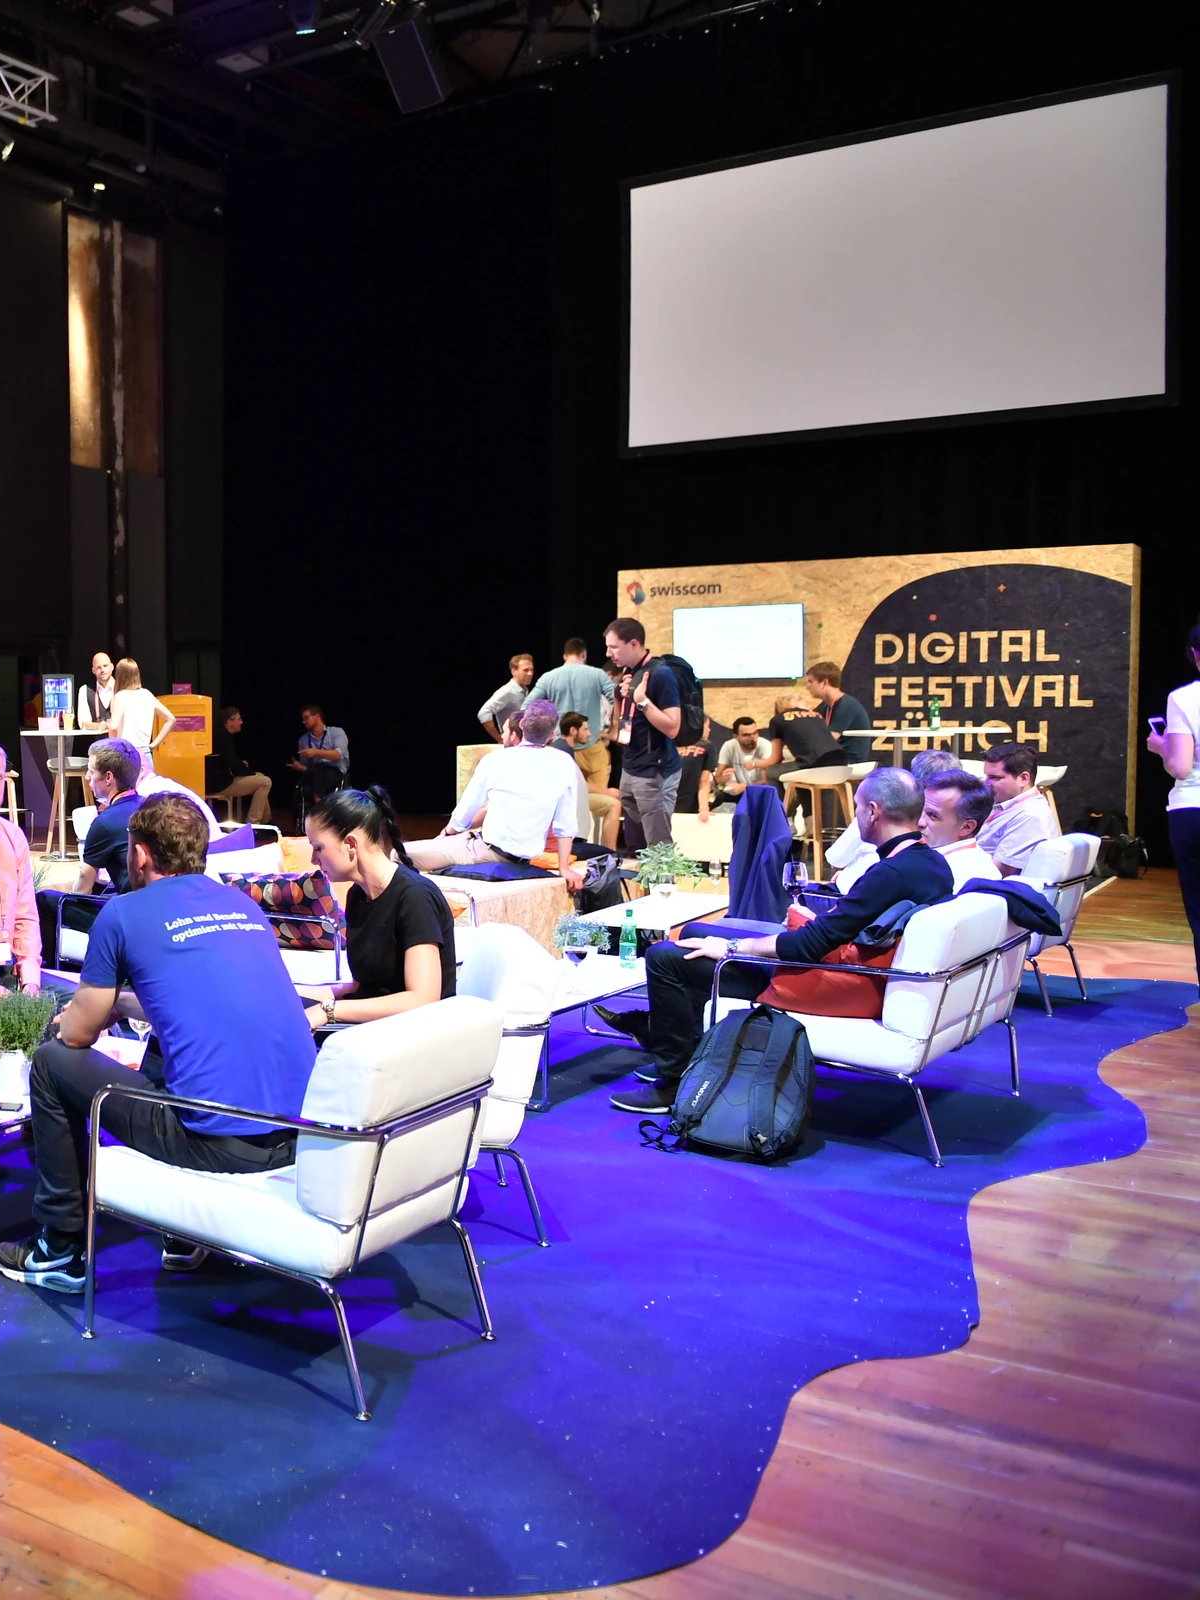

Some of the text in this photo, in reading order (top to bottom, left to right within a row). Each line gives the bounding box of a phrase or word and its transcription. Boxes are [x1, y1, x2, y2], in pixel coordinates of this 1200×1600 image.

[650, 582, 722, 597] swisscom
[874, 629, 1060, 665] DIGITAL
[873, 675, 1094, 708] FESTIVAL
[165, 917, 193, 930] Lohn
[193, 913, 213, 922] und
[172, 924, 222, 942] optimiert
[222, 922, 237, 931] mit
